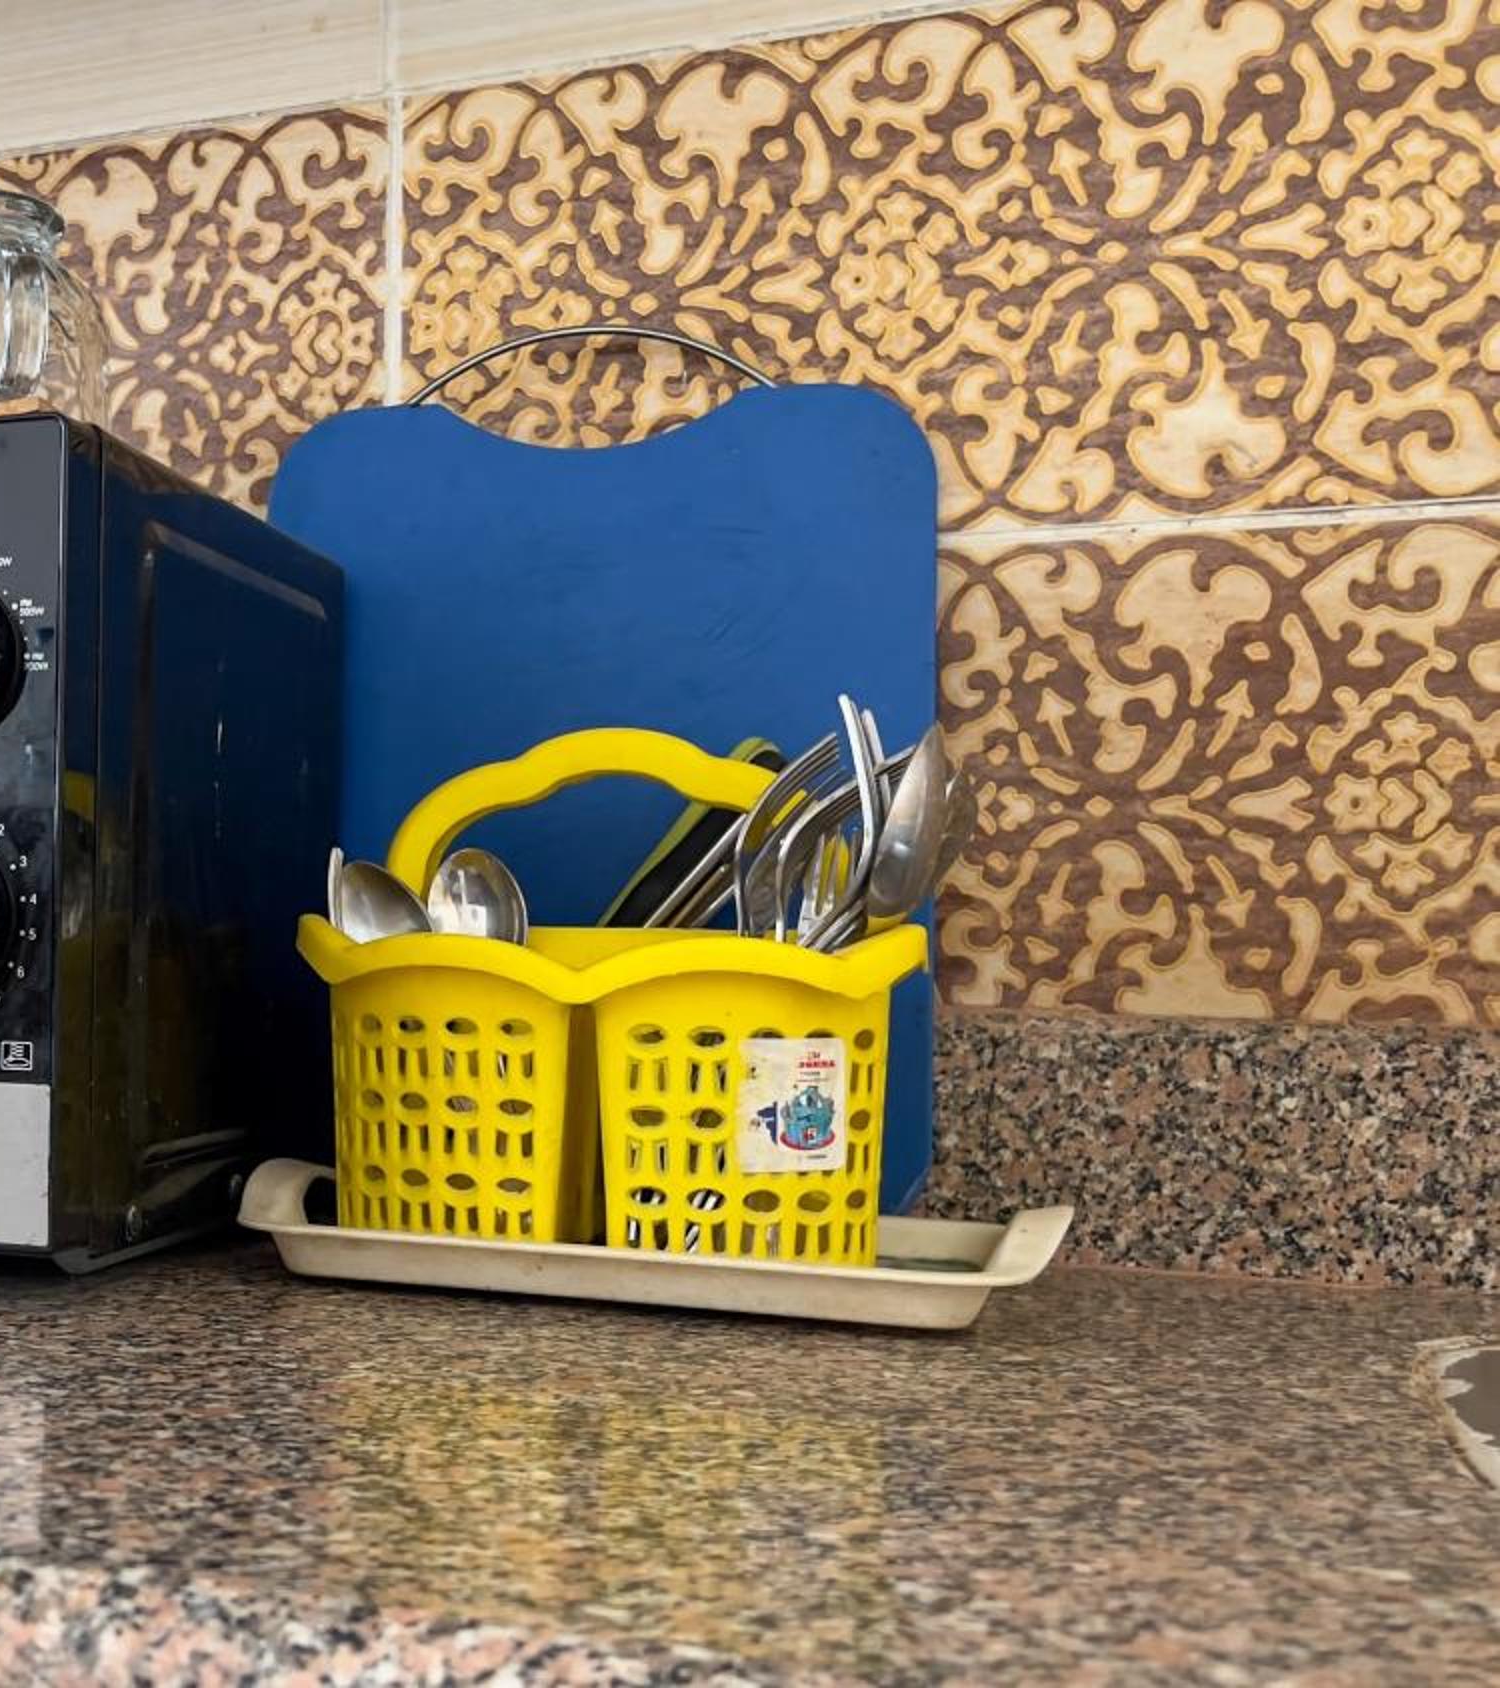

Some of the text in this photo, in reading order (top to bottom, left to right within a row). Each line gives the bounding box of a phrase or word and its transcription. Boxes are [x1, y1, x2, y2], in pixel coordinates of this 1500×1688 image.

[19, 855, 28, 868] 3
[29, 893, 37, 905] 4
[29, 928, 37, 941] 5
[17, 965, 25, 978] 6
